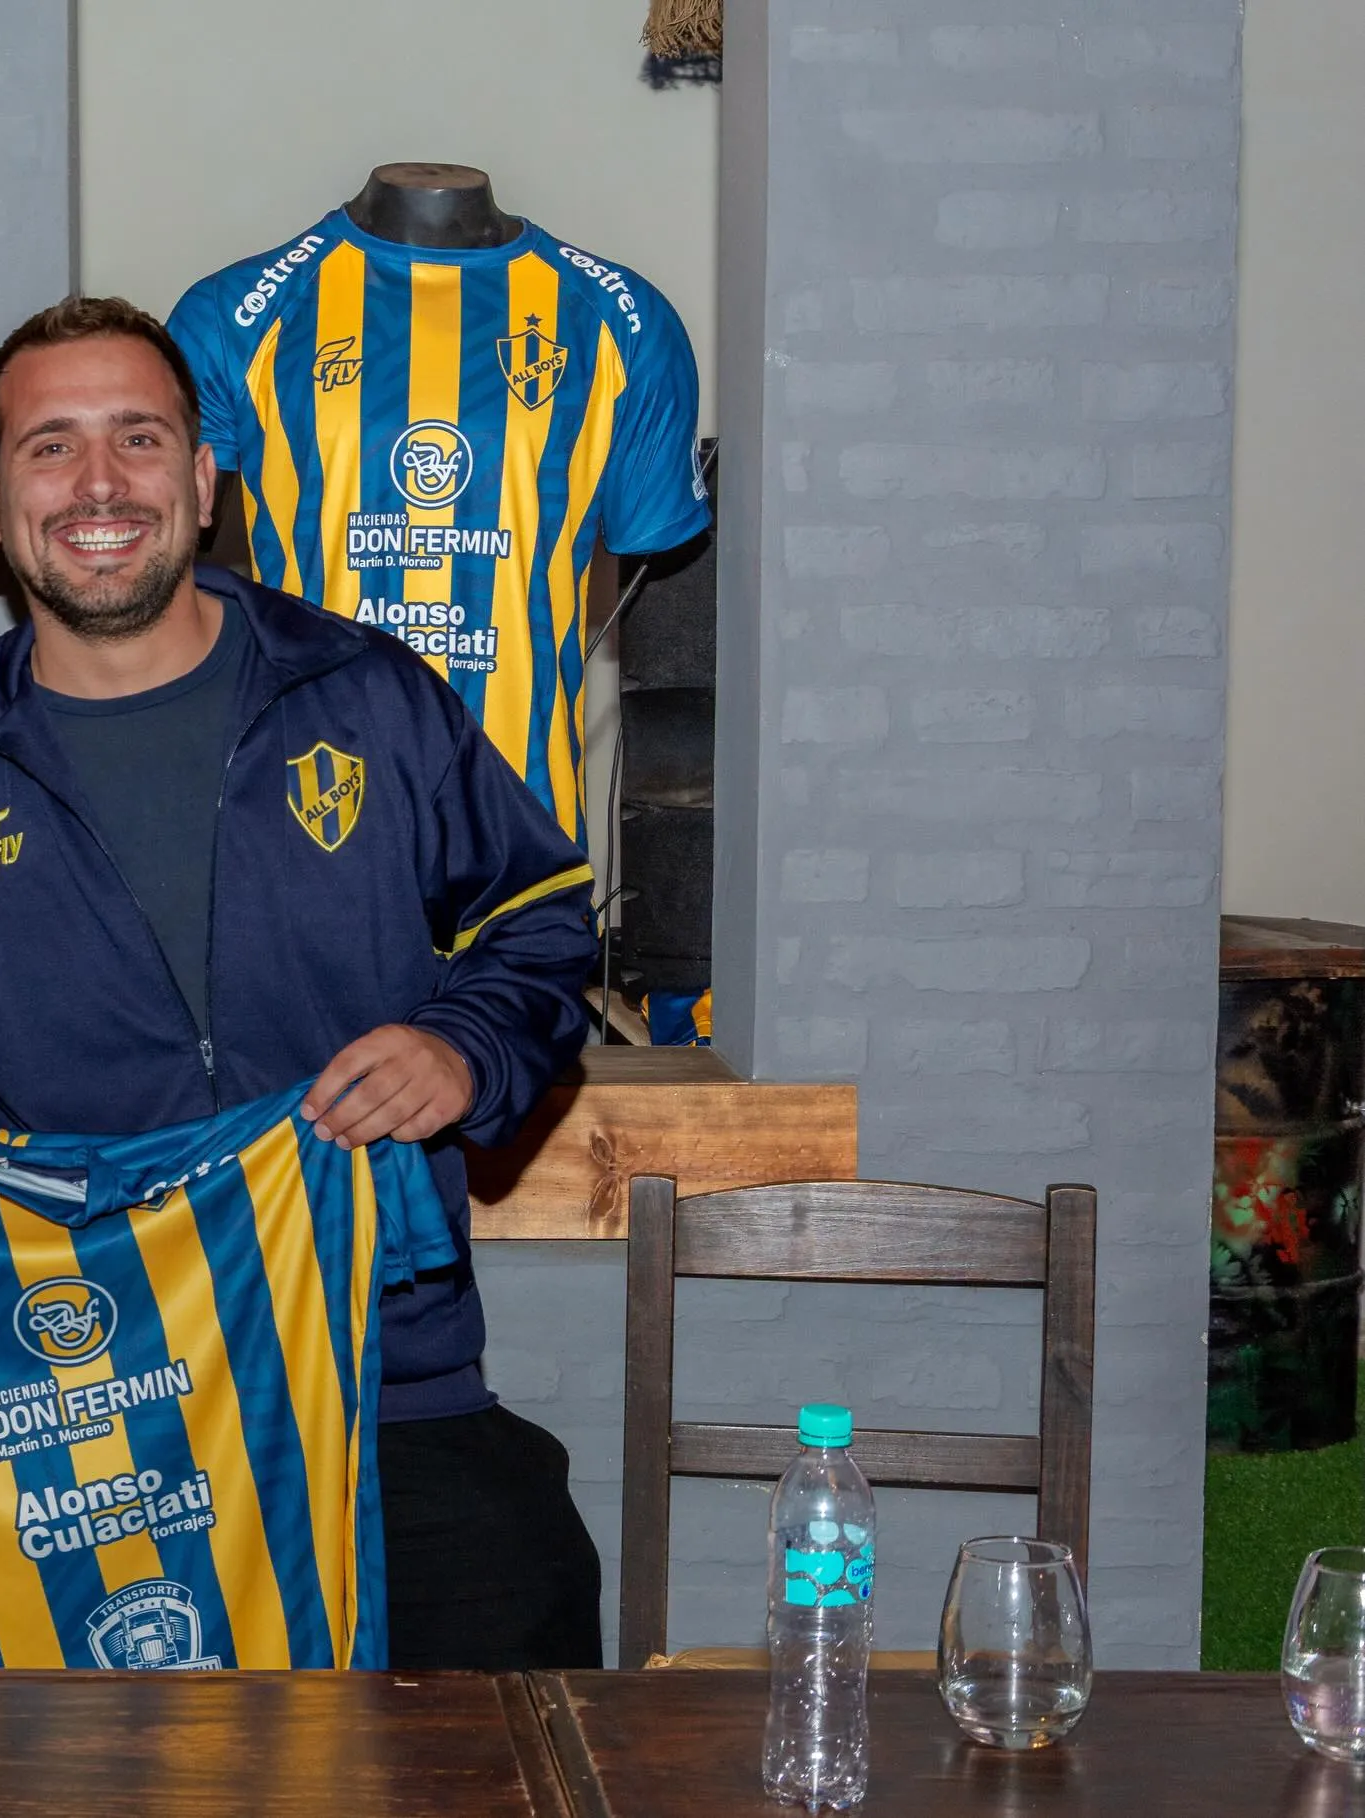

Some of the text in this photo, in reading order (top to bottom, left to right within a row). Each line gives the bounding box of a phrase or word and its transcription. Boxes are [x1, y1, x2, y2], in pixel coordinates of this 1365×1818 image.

[234, 235, 325, 327] costren
[559, 246, 642, 334] costren
[512, 354, 563, 385] ALL BOYS
[349, 513, 407, 527] HACIENDAS
[349, 528, 509, 556] DON FERMIN
[350, 556, 440, 568] Martín D. Moreno
[356, 598, 465, 625] Alonso
[387, 625, 496, 656] laciati
[447, 656, 495, 672] forrajes
[305, 771, 360, 824] ALL BOYS
[64, 1362, 190, 1422] FERMIN
[42, 1433, 57, 1448] D.
[58, 1421, 111, 1444] Moreno
[17, 1469, 163, 1528] Alonso
[21, 1473, 211, 1559] Culaciati
[151, 1513, 214, 1541] forrajes
[99, 1585, 180, 1617] TRANSPORTE
